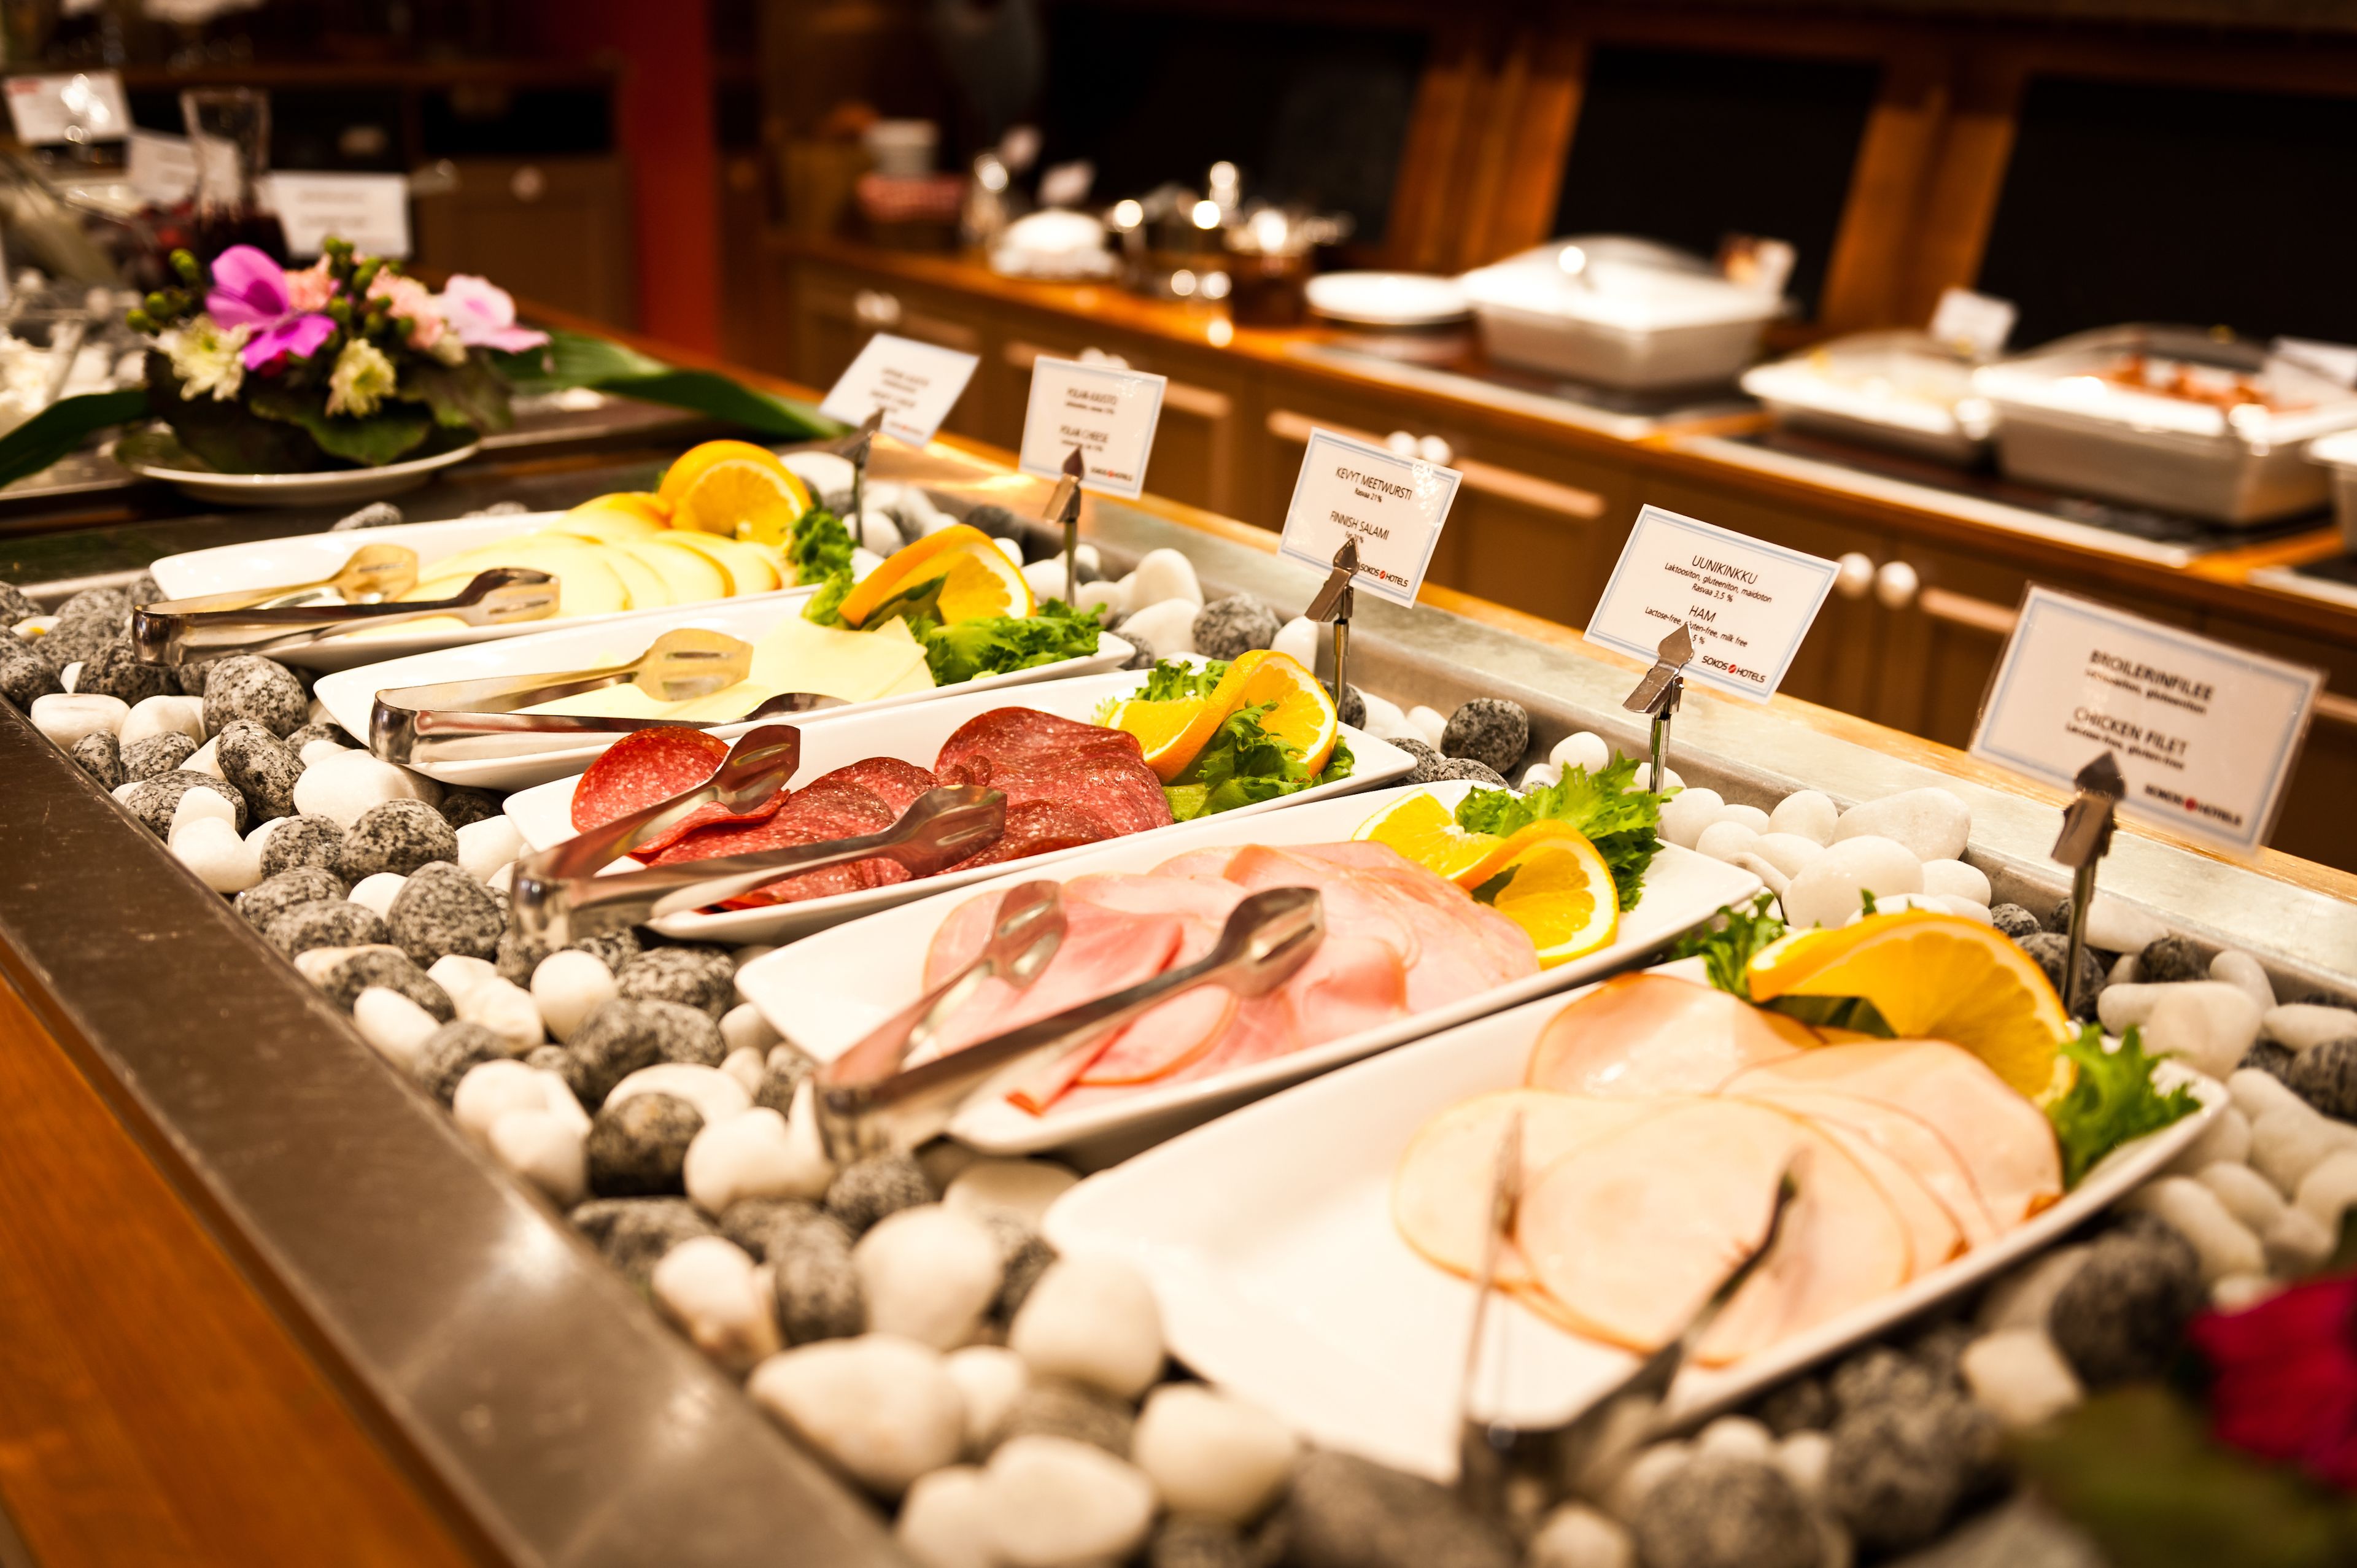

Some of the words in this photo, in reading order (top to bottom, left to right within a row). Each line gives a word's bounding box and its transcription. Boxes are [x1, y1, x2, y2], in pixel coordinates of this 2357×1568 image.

[1336, 467, 1361, 483] KEVYT
[1361, 475, 1413, 501] MEETWURSTI
[1330, 511, 1359, 529] FINNISH
[1359, 521, 1390, 540] SALAMI
[1360, 564, 1379, 577] SOKOS
[1385, 573, 1409, 587] HOTELS
[1665, 563, 1701, 582] Laktoositon,
[1703, 576, 1739, 594] gluteeniton,
[1741, 589, 1772, 603] maidoton
[1692, 555, 1758, 585] UUNIKINKKU
[1692, 583, 1713, 596] Rasvaa
[1714, 590, 1725, 601] 3,5
[1727, 594, 1733, 603] %
[1645, 606, 1682, 626] Lactose-free,
[1686, 620, 1718, 638] uten-free,
[1720, 633, 1733, 643] milk
[1735, 636, 1748, 647] free
[1689, 605, 1717, 623] HAM
[1701, 655, 1728, 671] SOKOS
[1736, 668, 1767, 683] HOTELS
[2089, 650, 2214, 701] BROILERINFILEE
[2073, 706, 2142, 741] CHICKEN
[2145, 729, 2188, 755] FILET
